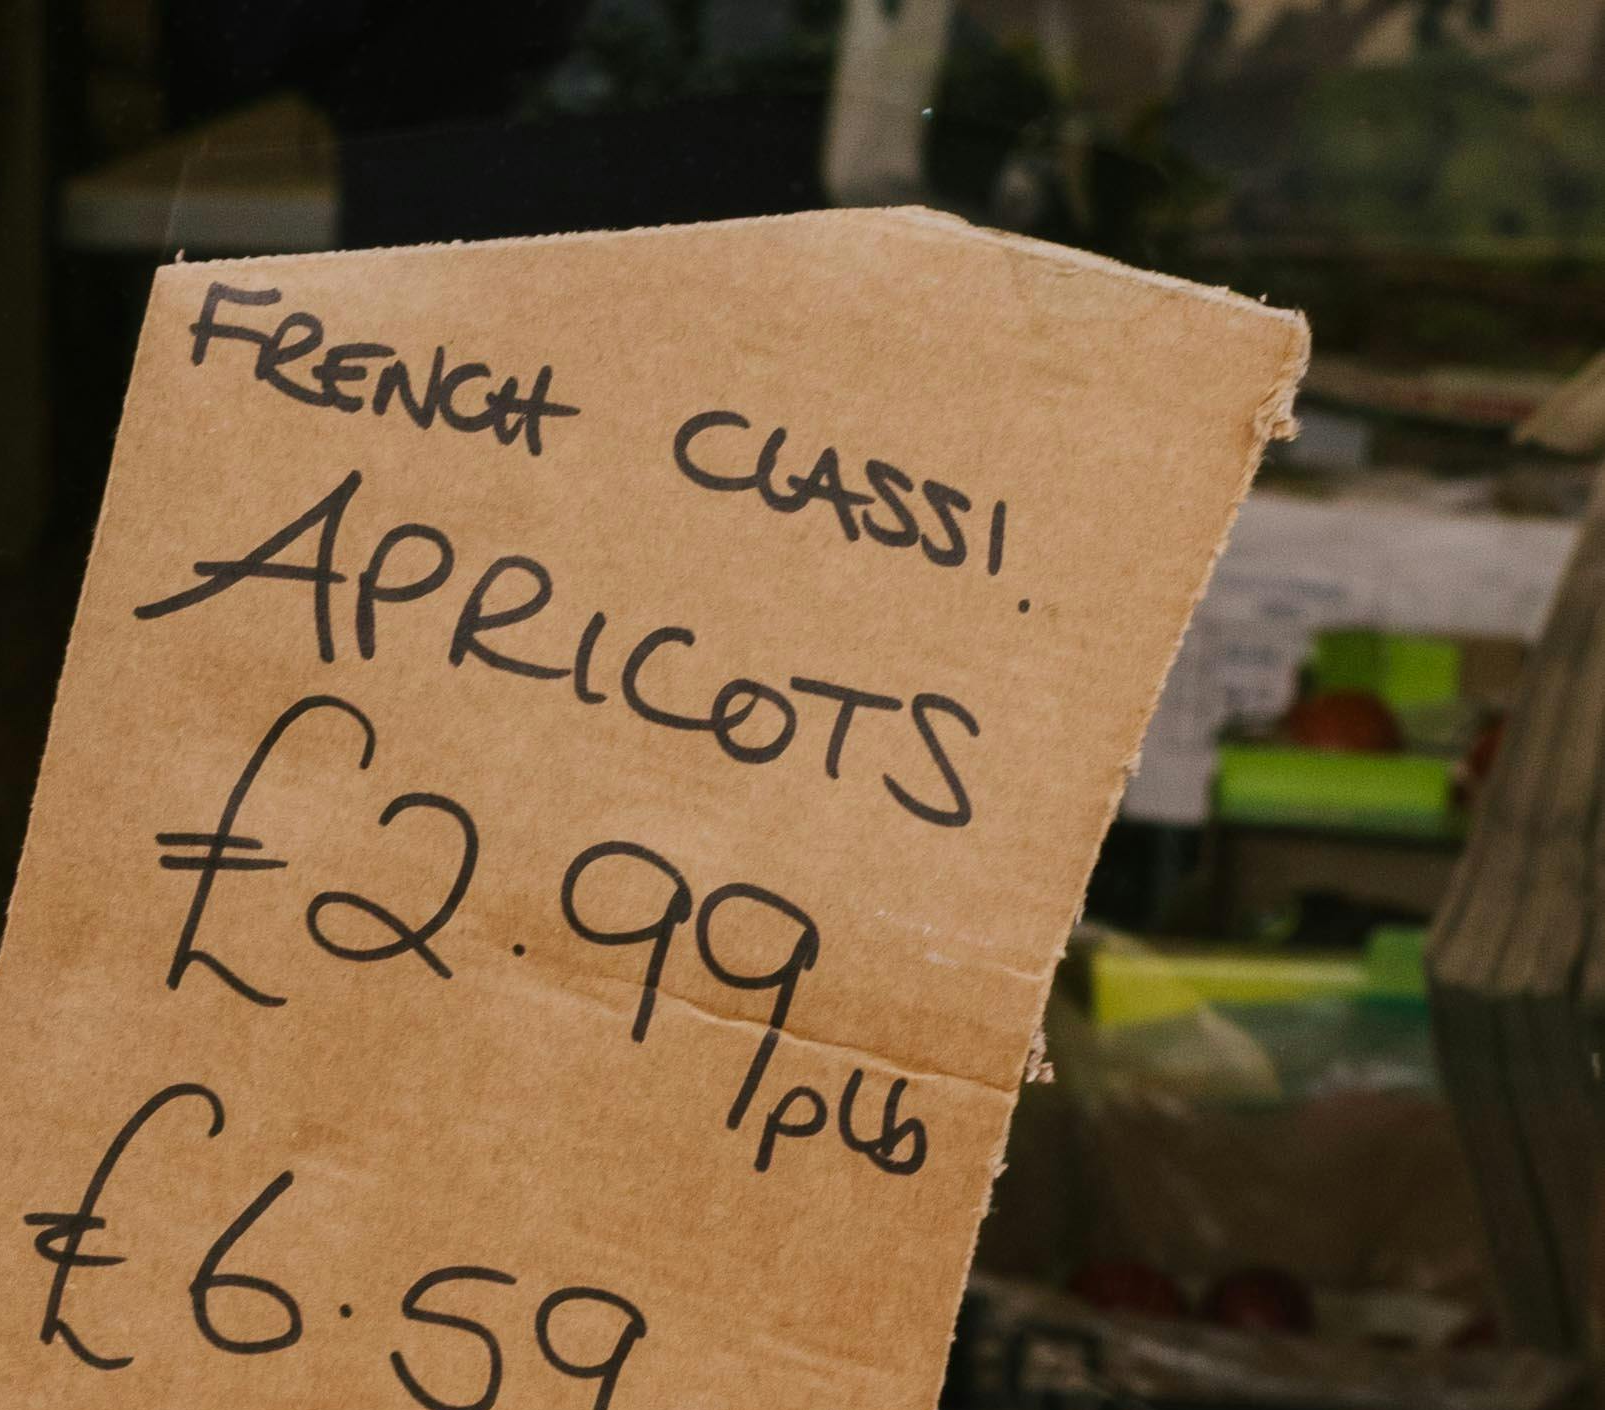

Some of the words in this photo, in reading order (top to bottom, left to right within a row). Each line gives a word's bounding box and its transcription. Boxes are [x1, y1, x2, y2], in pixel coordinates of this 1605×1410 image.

[191, 284, 581, 457] FRENCH
[133, 470, 980, 827] APRICOTS
[154, 694, 820, 1131] £2.99
